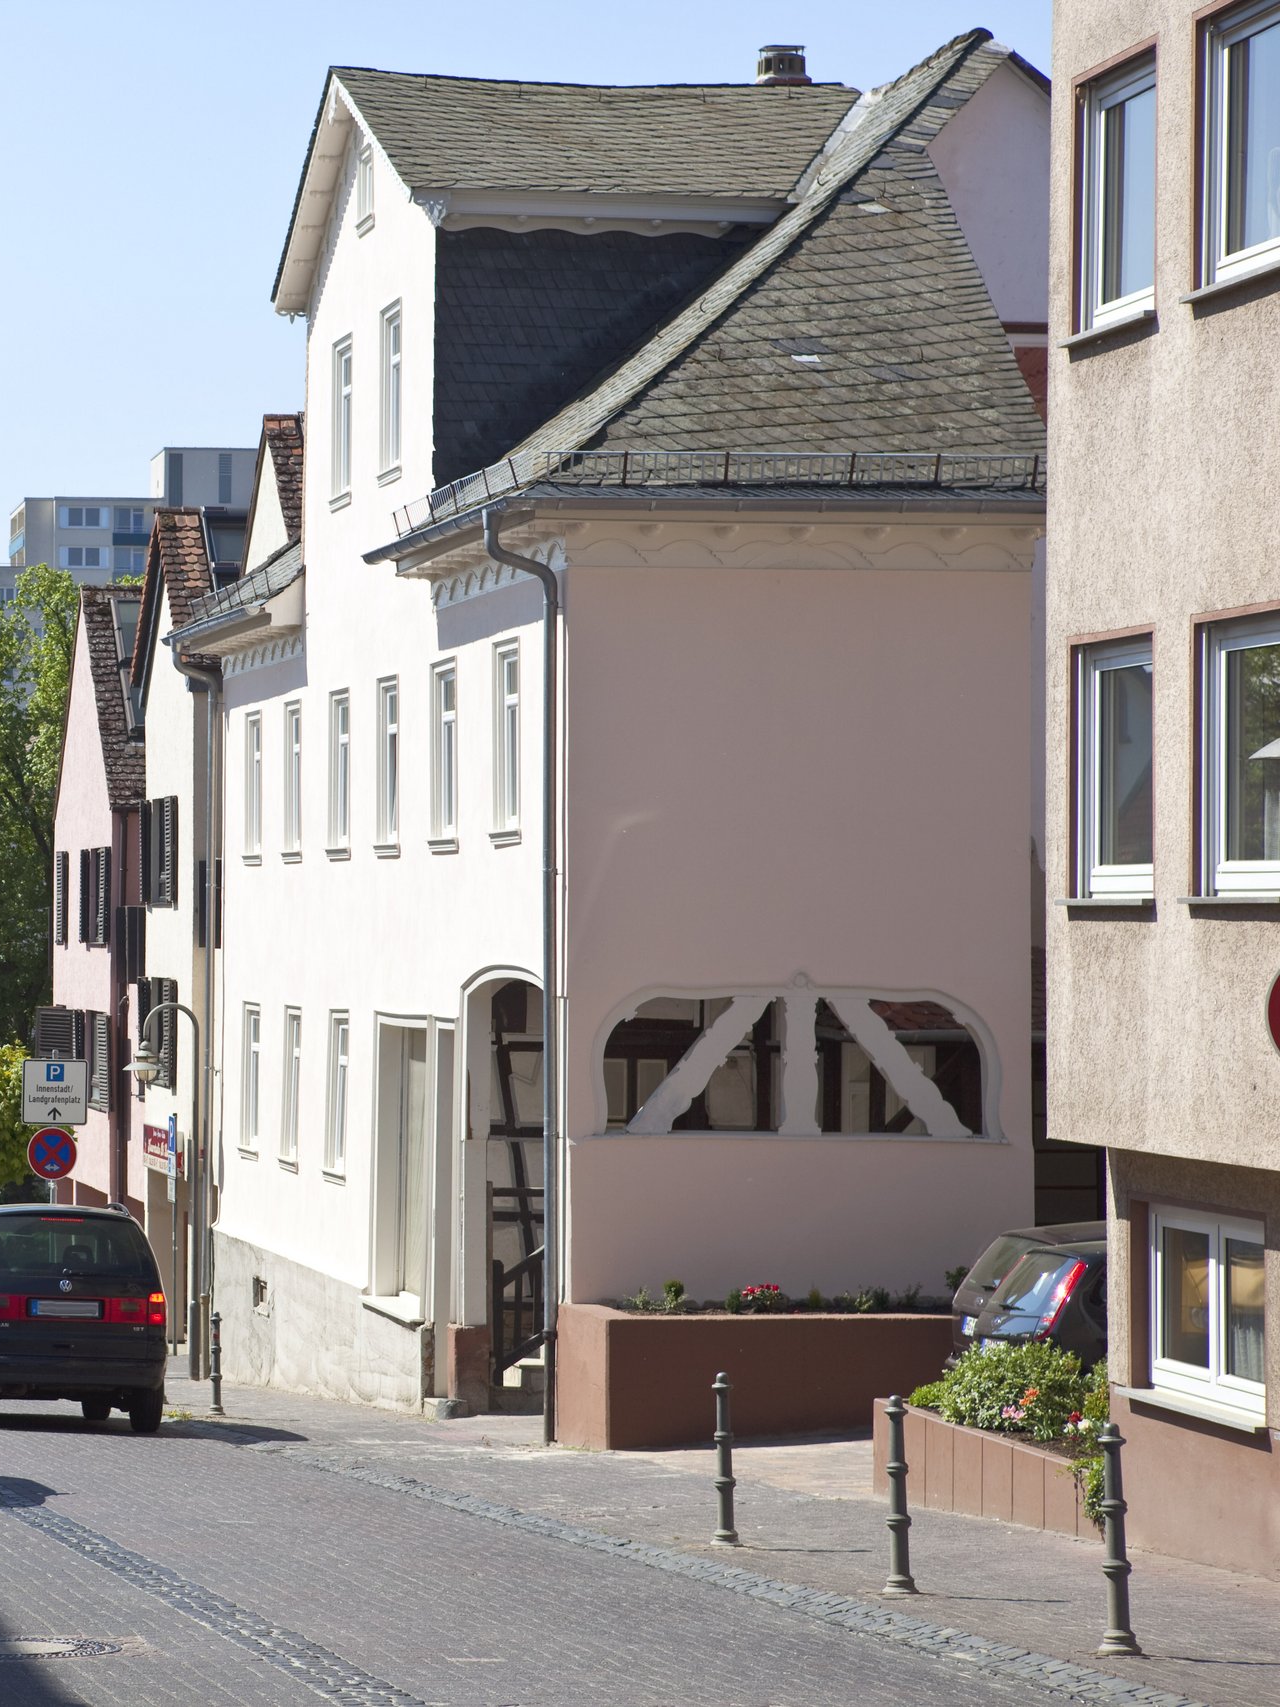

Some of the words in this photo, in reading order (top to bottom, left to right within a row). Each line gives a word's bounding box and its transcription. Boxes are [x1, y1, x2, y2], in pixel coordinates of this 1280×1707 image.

[50, 1065, 61, 1080] P
[36, 1084, 74, 1093] Innenstadt/
[28, 1094, 81, 1105] Landgrafenplatz
